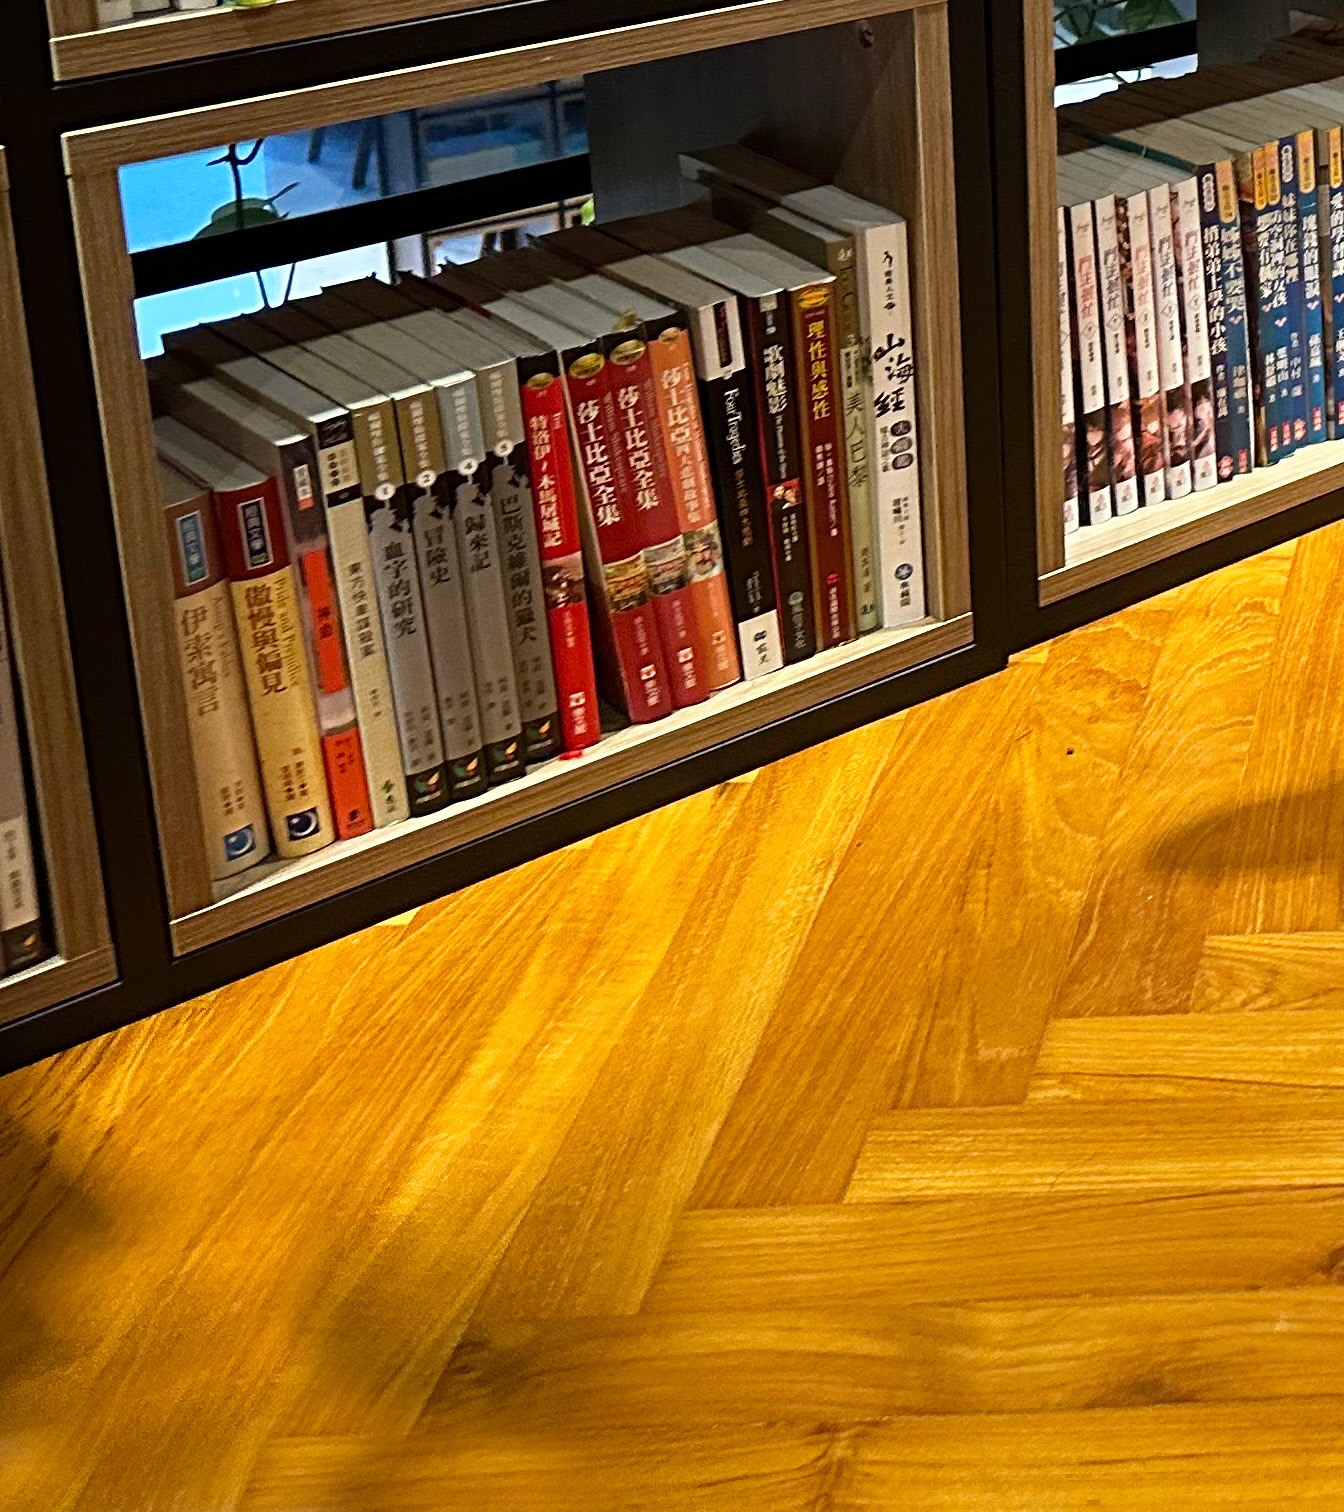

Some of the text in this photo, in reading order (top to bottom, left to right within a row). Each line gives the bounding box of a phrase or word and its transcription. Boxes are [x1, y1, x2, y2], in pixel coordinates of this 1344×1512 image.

[807, 320, 831, 422] 理性與感性
[873, 333, 914, 419] 山海經
[577, 399, 621, 528] 莎士比亞全集
[617, 385, 659, 511] 莎士比亞全集
[180, 605, 220, 716] 伊索寓言
[245, 584, 287, 696] 傲慢與偏見
